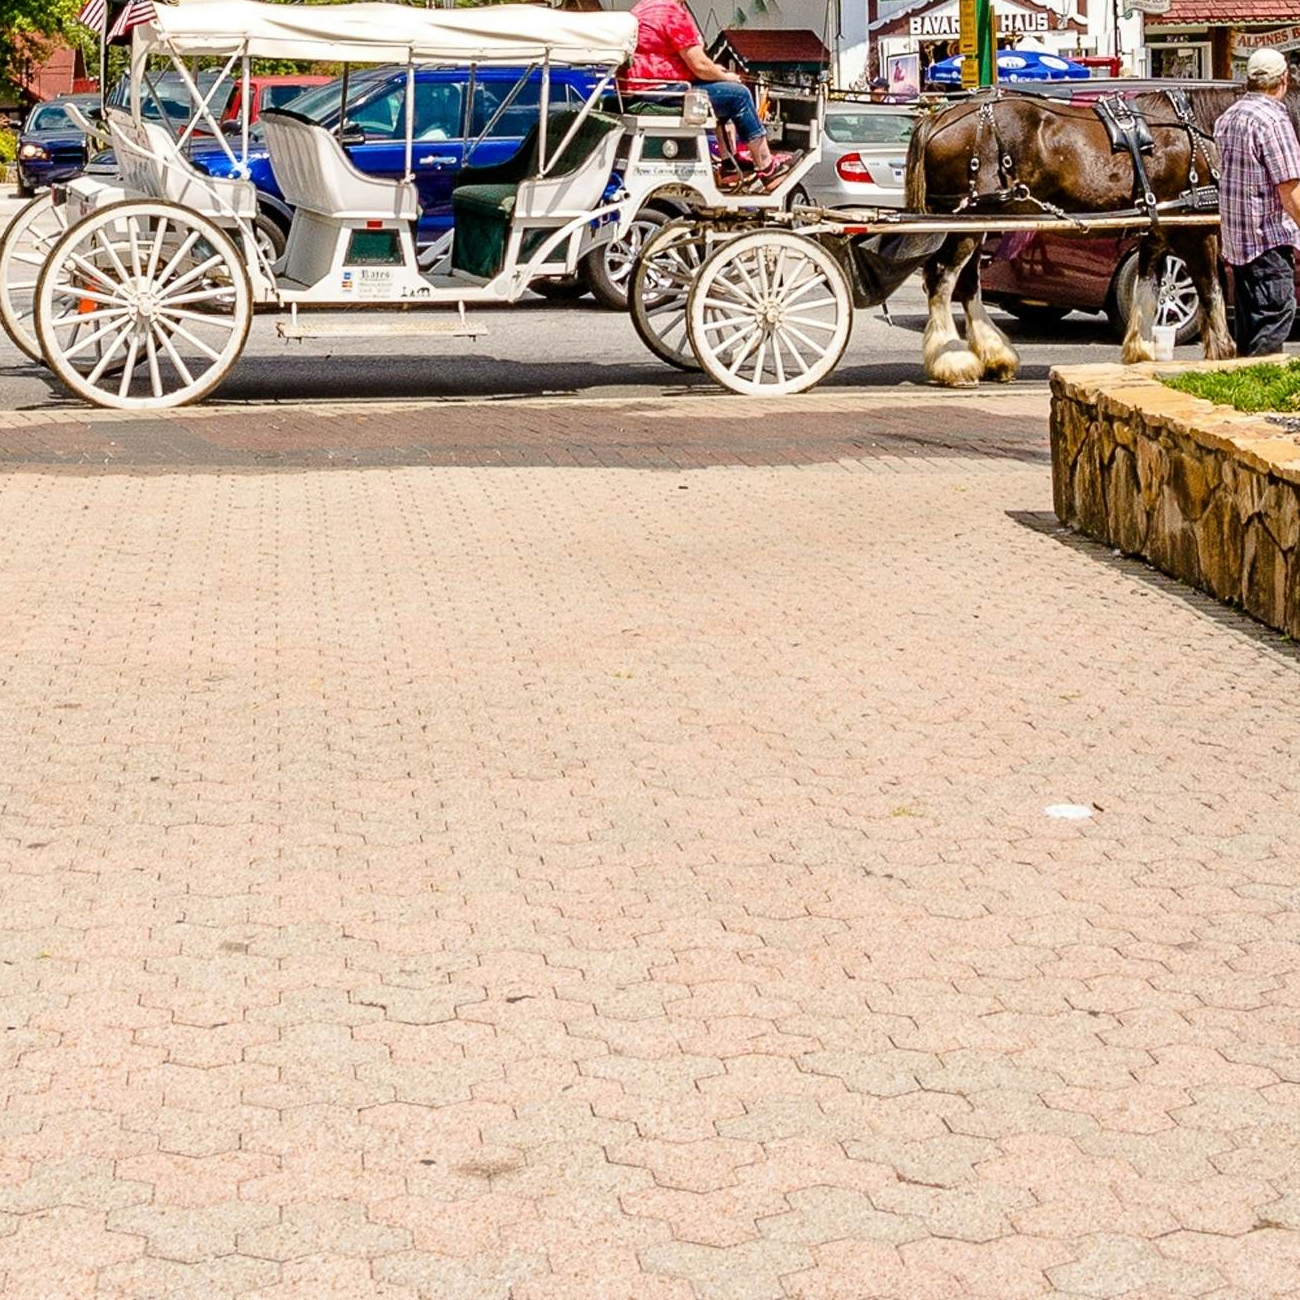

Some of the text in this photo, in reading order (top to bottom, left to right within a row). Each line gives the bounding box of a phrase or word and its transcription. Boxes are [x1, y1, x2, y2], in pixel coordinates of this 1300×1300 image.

[909, 13, 1048, 35] BAVAR HAUS
[1237, 29, 1289, 48] ALPINES
